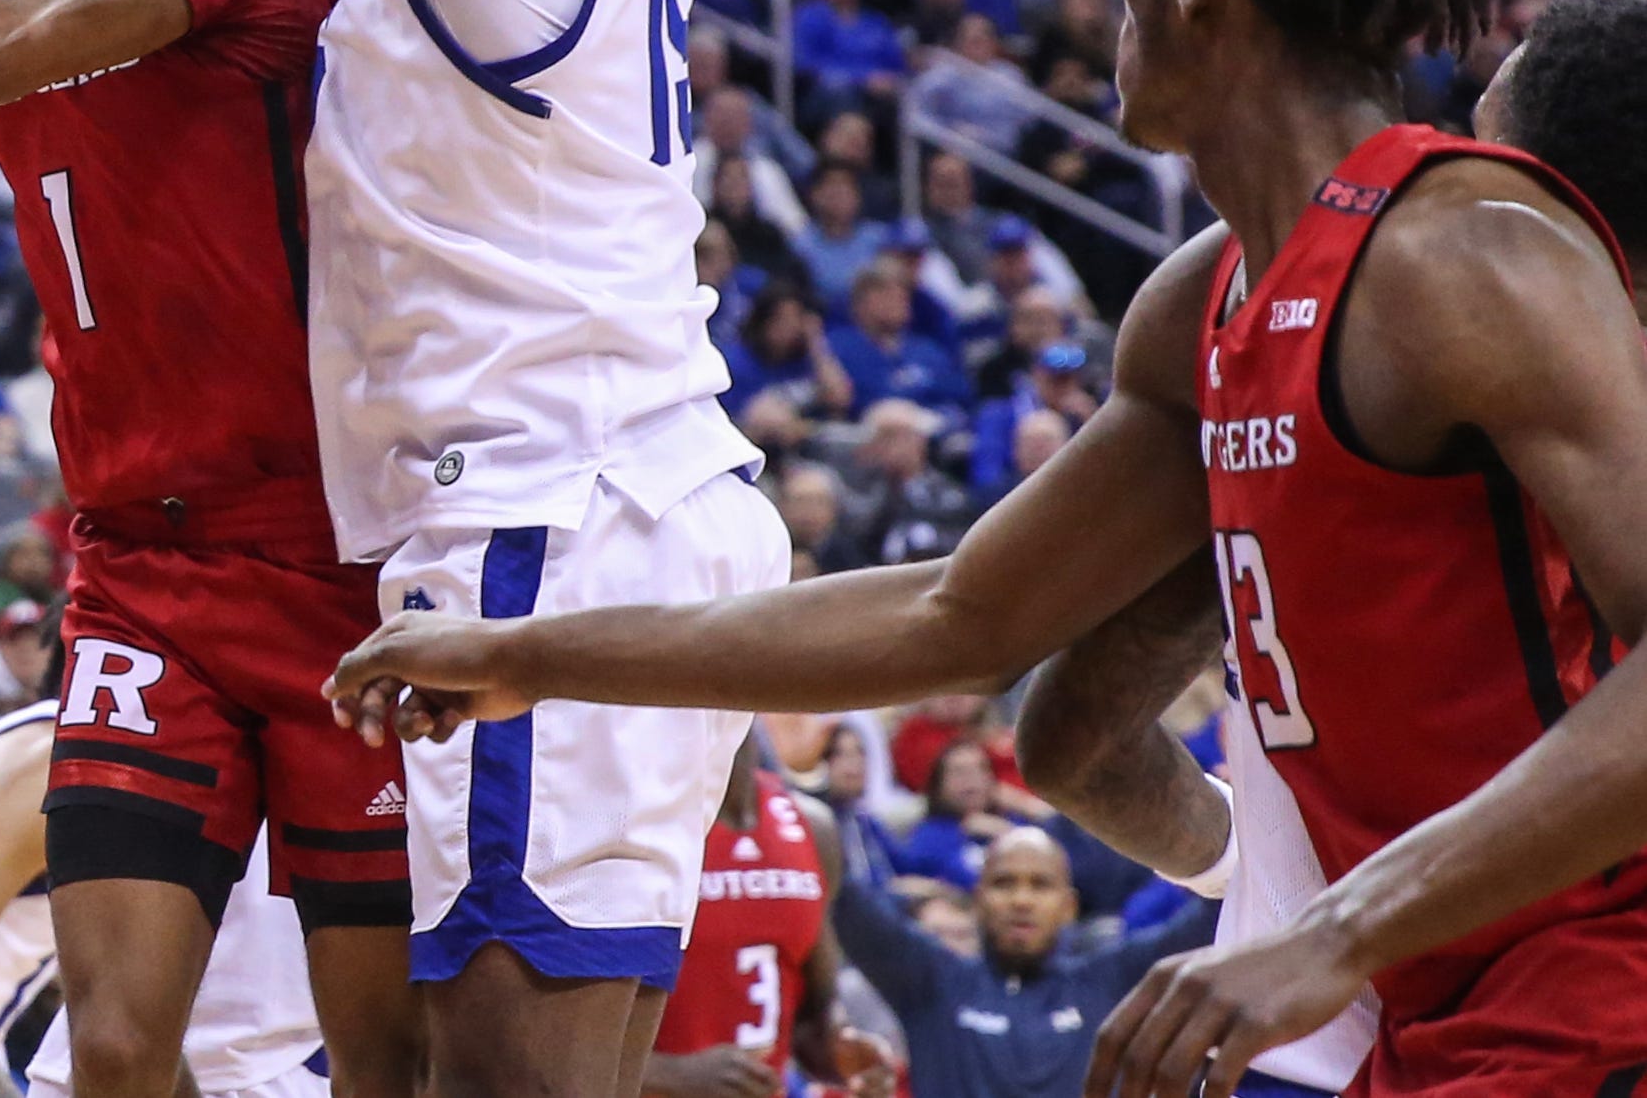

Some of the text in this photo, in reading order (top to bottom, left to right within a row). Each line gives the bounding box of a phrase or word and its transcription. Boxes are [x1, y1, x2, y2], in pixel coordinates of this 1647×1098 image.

[40, 168, 97, 332] 1
[59, 638, 165, 736] R
[365, 803, 405, 816] adida
[699, 868, 823, 902] UTGERS
[734, 943, 781, 1049] 3
